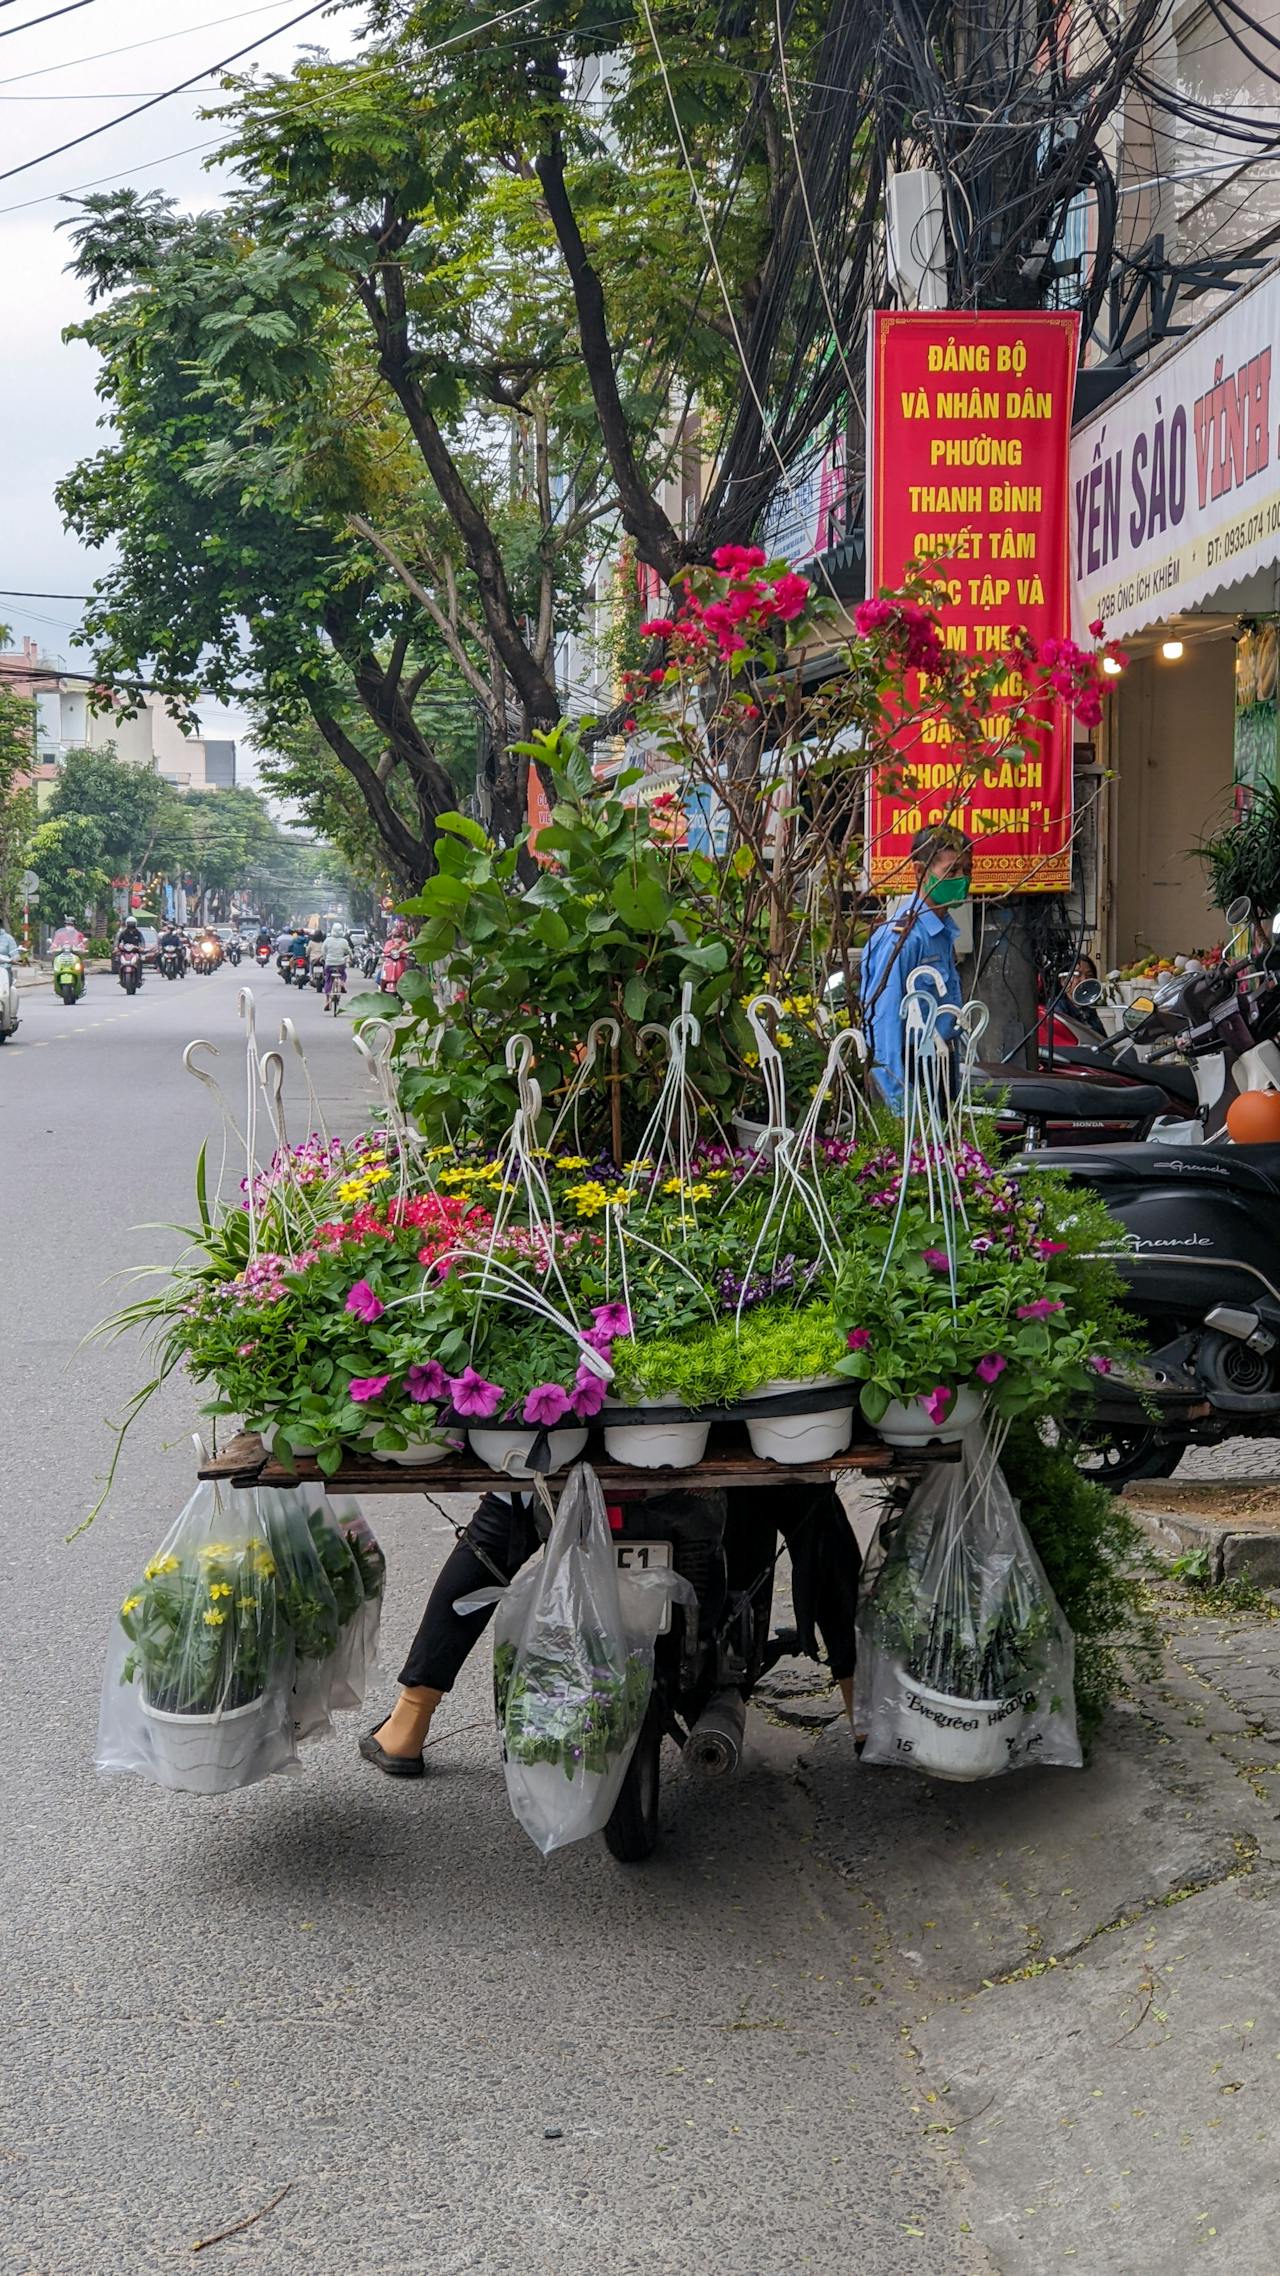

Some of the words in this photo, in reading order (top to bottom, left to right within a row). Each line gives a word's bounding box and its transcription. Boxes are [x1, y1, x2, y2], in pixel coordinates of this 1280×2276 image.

[928, 336, 990, 372] ĐẢNG
[997, 340, 1027, 377] BỘ
[901, 387, 930, 419] VÀ
[937, 387, 1000, 419] NHÂN
[1006, 387, 1052, 419] DÂN
[931, 433, 1022, 466] PHƯỜNG
[1076, 424, 1123, 581] YẾN
[1130, 395, 1187, 549] SÀO
[1194, 344, 1272, 511] VĨNH
[909, 486, 982, 513] THANH
[989, 481, 1042, 513] BÌNH
[913, 525, 983, 562] QUYẾT
[989, 528, 1036, 559] TÂM
[968, 574, 1010, 611] TẬP
[1017, 574, 1045, 605] VÀ
[1116, 580, 1135, 612] ÔNG
[1136, 571, 1151, 601] ÍCH
[1152, 555, 1181, 595] KHIÊM
[921, 717, 964, 749] ĐẠ
[1169, 1159, 1231, 1175] Grande
[1120, 1232, 1215, 1252] Grande
[896, 1737, 914, 1752] 15
